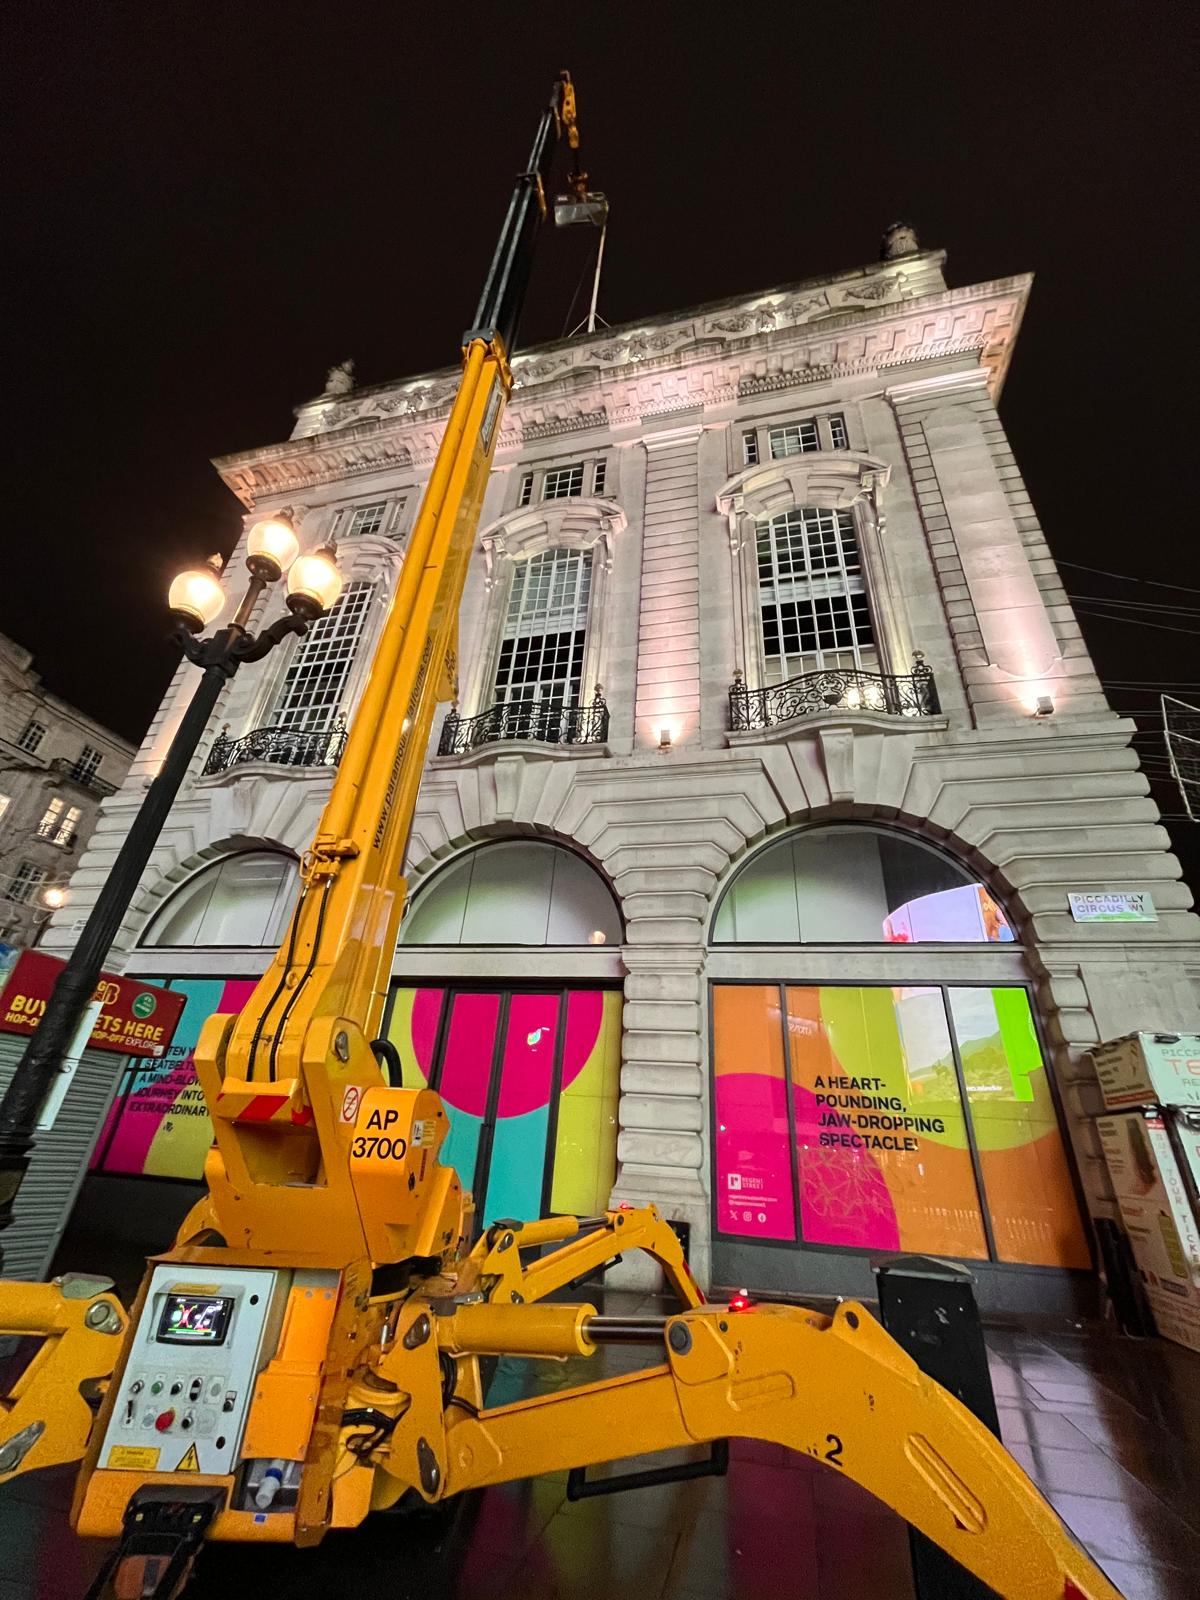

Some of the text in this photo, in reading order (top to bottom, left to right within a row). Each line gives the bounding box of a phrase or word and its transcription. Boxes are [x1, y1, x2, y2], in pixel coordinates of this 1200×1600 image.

[1074, 895, 1143, 904] PICCADILLY
[1077, 903, 1143, 912] CIRCUS W1
[5, 1012, 40, 1027] HOP-O
[123, 1020, 164, 1042] HERE
[814, 1075, 886, 1091] A HEART-
[181, 1090, 205, 1101] INTO
[816, 1094, 907, 1113] POUNDING,
[366, 1109, 399, 1131] AP
[818, 1113, 945, 1133] JAW-DROPPING
[352, 1137, 407, 1160] 3700
[819, 1132, 919, 1152] SPECTACLE!
[1166, 1168, 1183, 1205] TOUR
[1181, 1214, 1200, 1264] TICKE
[825, 1433, 843, 1467] 2
